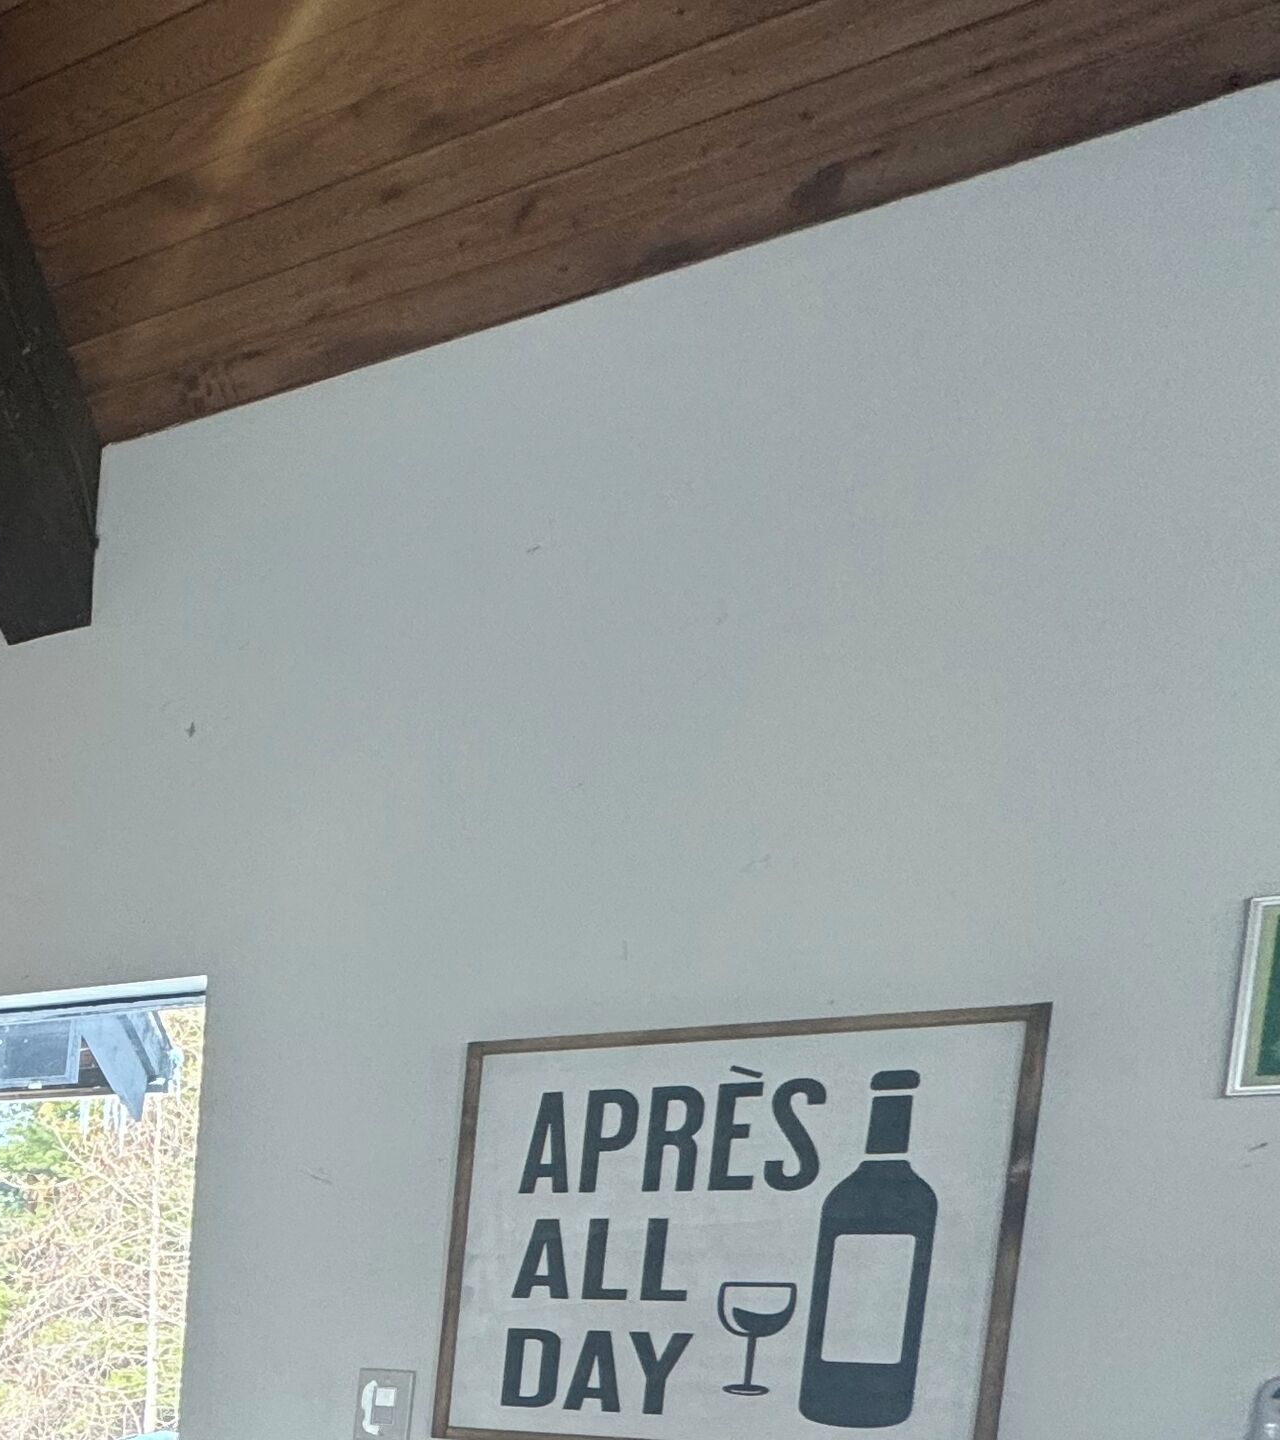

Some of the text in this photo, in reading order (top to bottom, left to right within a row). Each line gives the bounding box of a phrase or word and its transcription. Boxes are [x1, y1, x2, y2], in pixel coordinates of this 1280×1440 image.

[518, 1065, 828, 1194] APRÈS
[511, 1217, 688, 1302] ALL
[500, 1327, 694, 1415] DAY
